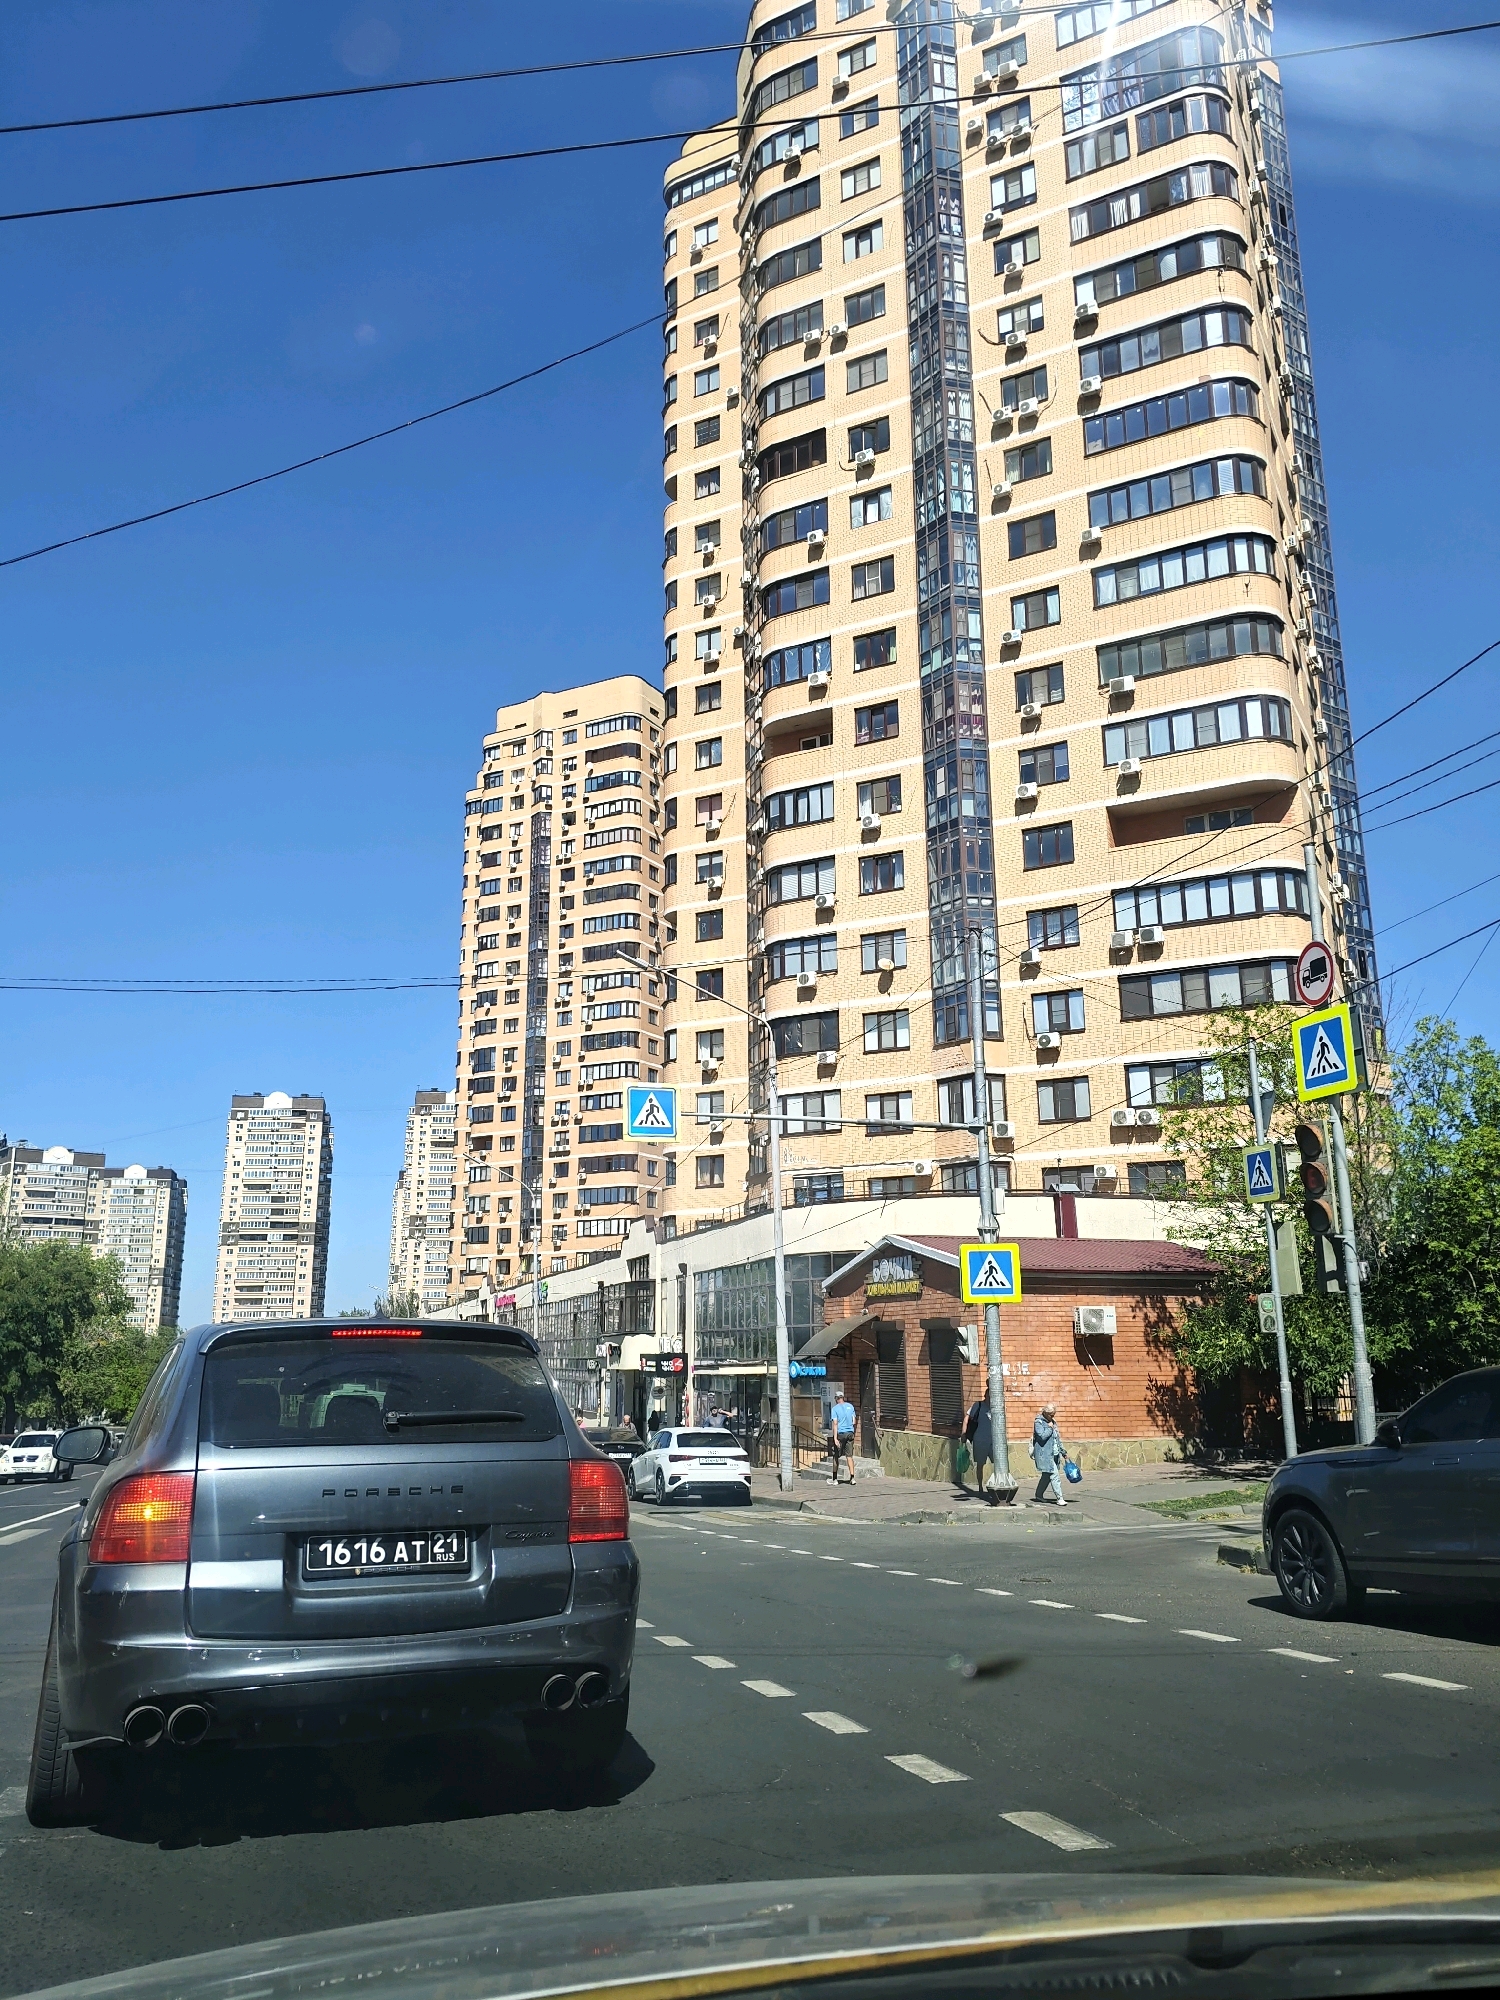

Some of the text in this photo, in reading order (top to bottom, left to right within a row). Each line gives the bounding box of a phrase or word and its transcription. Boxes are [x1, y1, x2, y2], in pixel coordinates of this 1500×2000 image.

[872, 1255, 914, 1283] БОЧКИ
[322, 1485, 464, 1498] PORSCHE
[319, 1533, 458, 1566] 1616 AT 21
[436, 1553, 455, 1562] RUS
